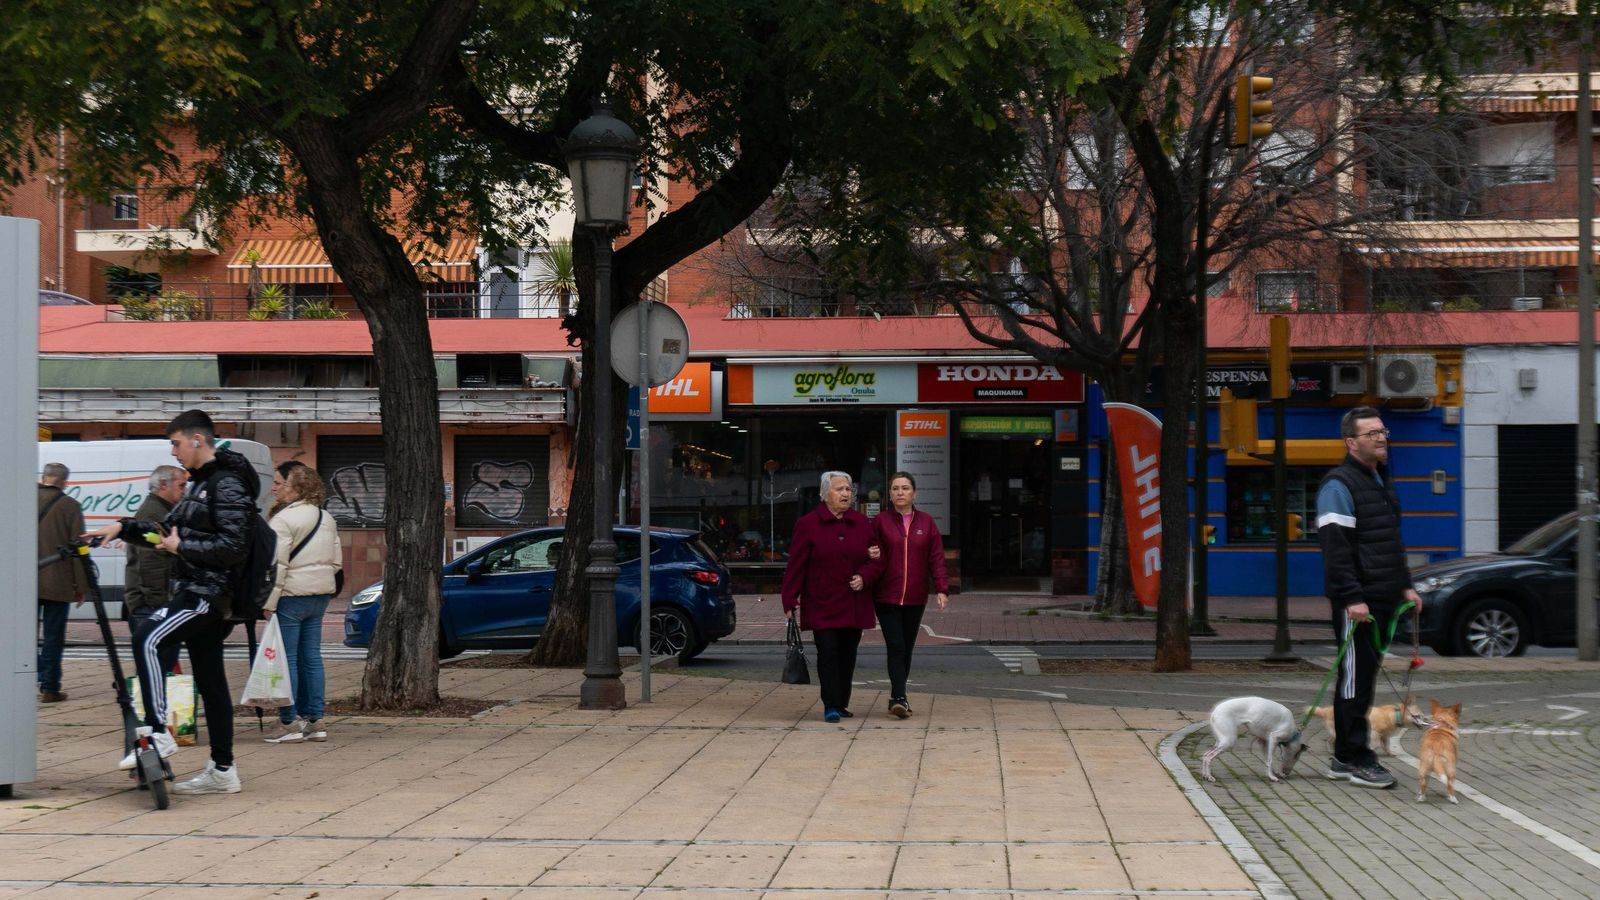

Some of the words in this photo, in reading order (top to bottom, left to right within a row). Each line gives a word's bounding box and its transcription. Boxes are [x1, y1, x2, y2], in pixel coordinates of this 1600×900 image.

[937, 365, 1065, 382] HONDA
[1206, 371, 1269, 382] ESPENSA
[794, 365, 876, 394] agroflora
[647, 379, 700, 396] IHL
[851, 387, 876, 395] Onuba
[977, 389, 1024, 397] MAQUINARIA
[904, 420, 942, 430] STIHL
